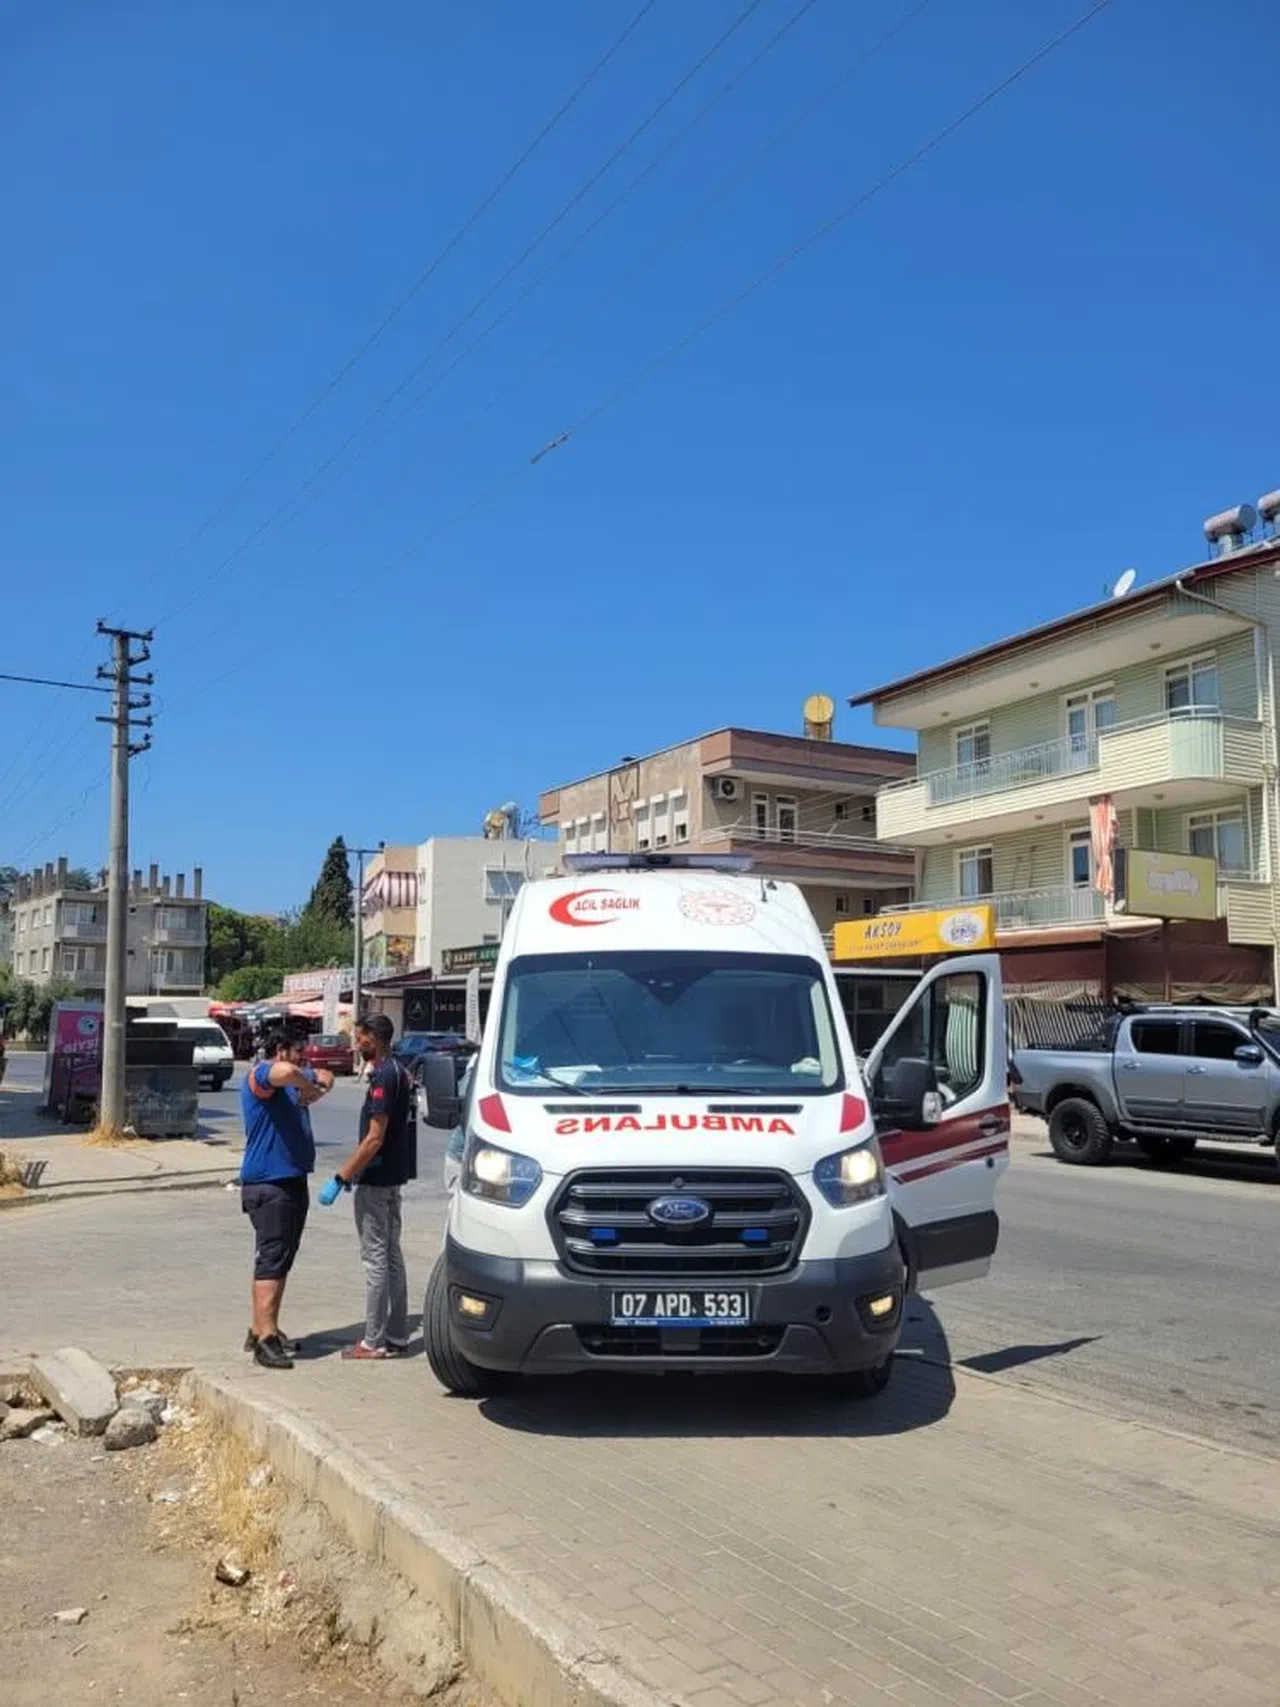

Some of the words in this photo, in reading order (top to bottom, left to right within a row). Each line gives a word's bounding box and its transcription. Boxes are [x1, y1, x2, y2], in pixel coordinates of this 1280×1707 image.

[864, 921, 902, 939] AKSOY
[622, 1293, 647, 1316] 07
[655, 1293, 691, 1316] APD
[704, 1293, 742, 1316] 533
